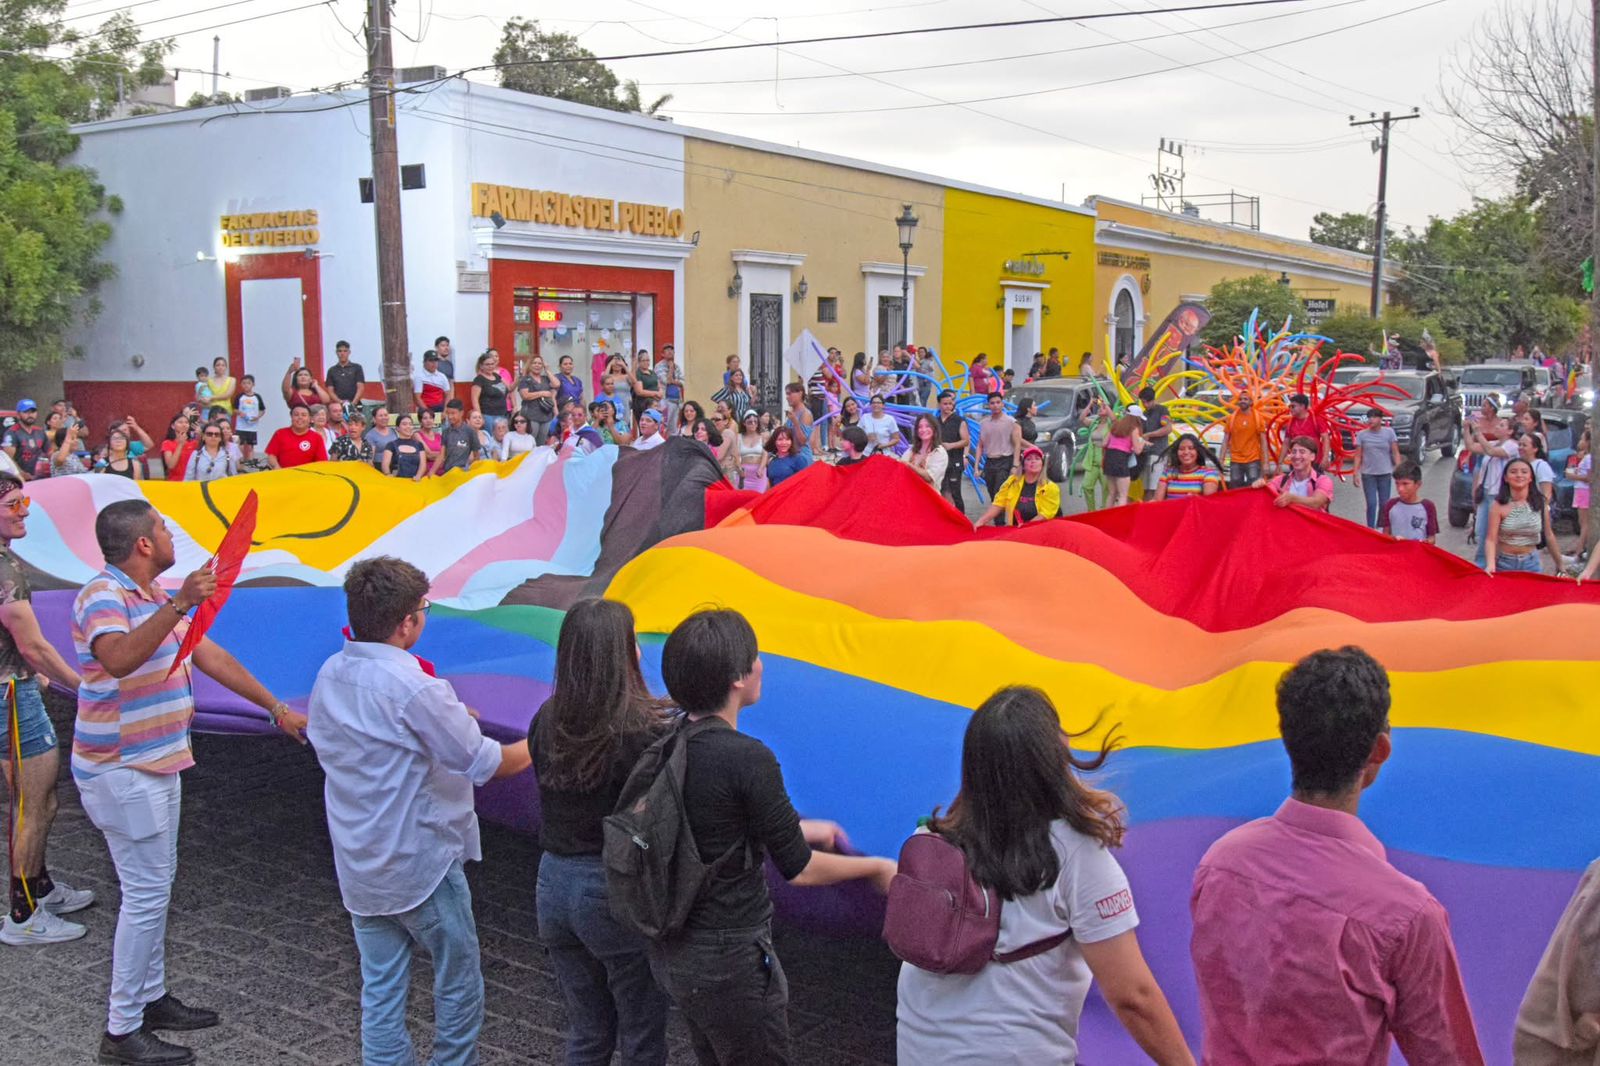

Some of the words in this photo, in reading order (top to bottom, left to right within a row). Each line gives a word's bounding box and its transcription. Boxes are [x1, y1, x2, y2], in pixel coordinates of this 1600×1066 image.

[221, 210, 318, 229] FARMACIAS
[472, 183, 584, 228] FARMACIAS
[584, 197, 620, 232] DEL
[618, 202, 685, 238] PUEBLO
[221, 232, 251, 247] DEL
[253, 229, 319, 246] PUEBLO
[1014, 293, 1033, 302] SUSHI
[1307, 300, 1329, 309] Hotel
